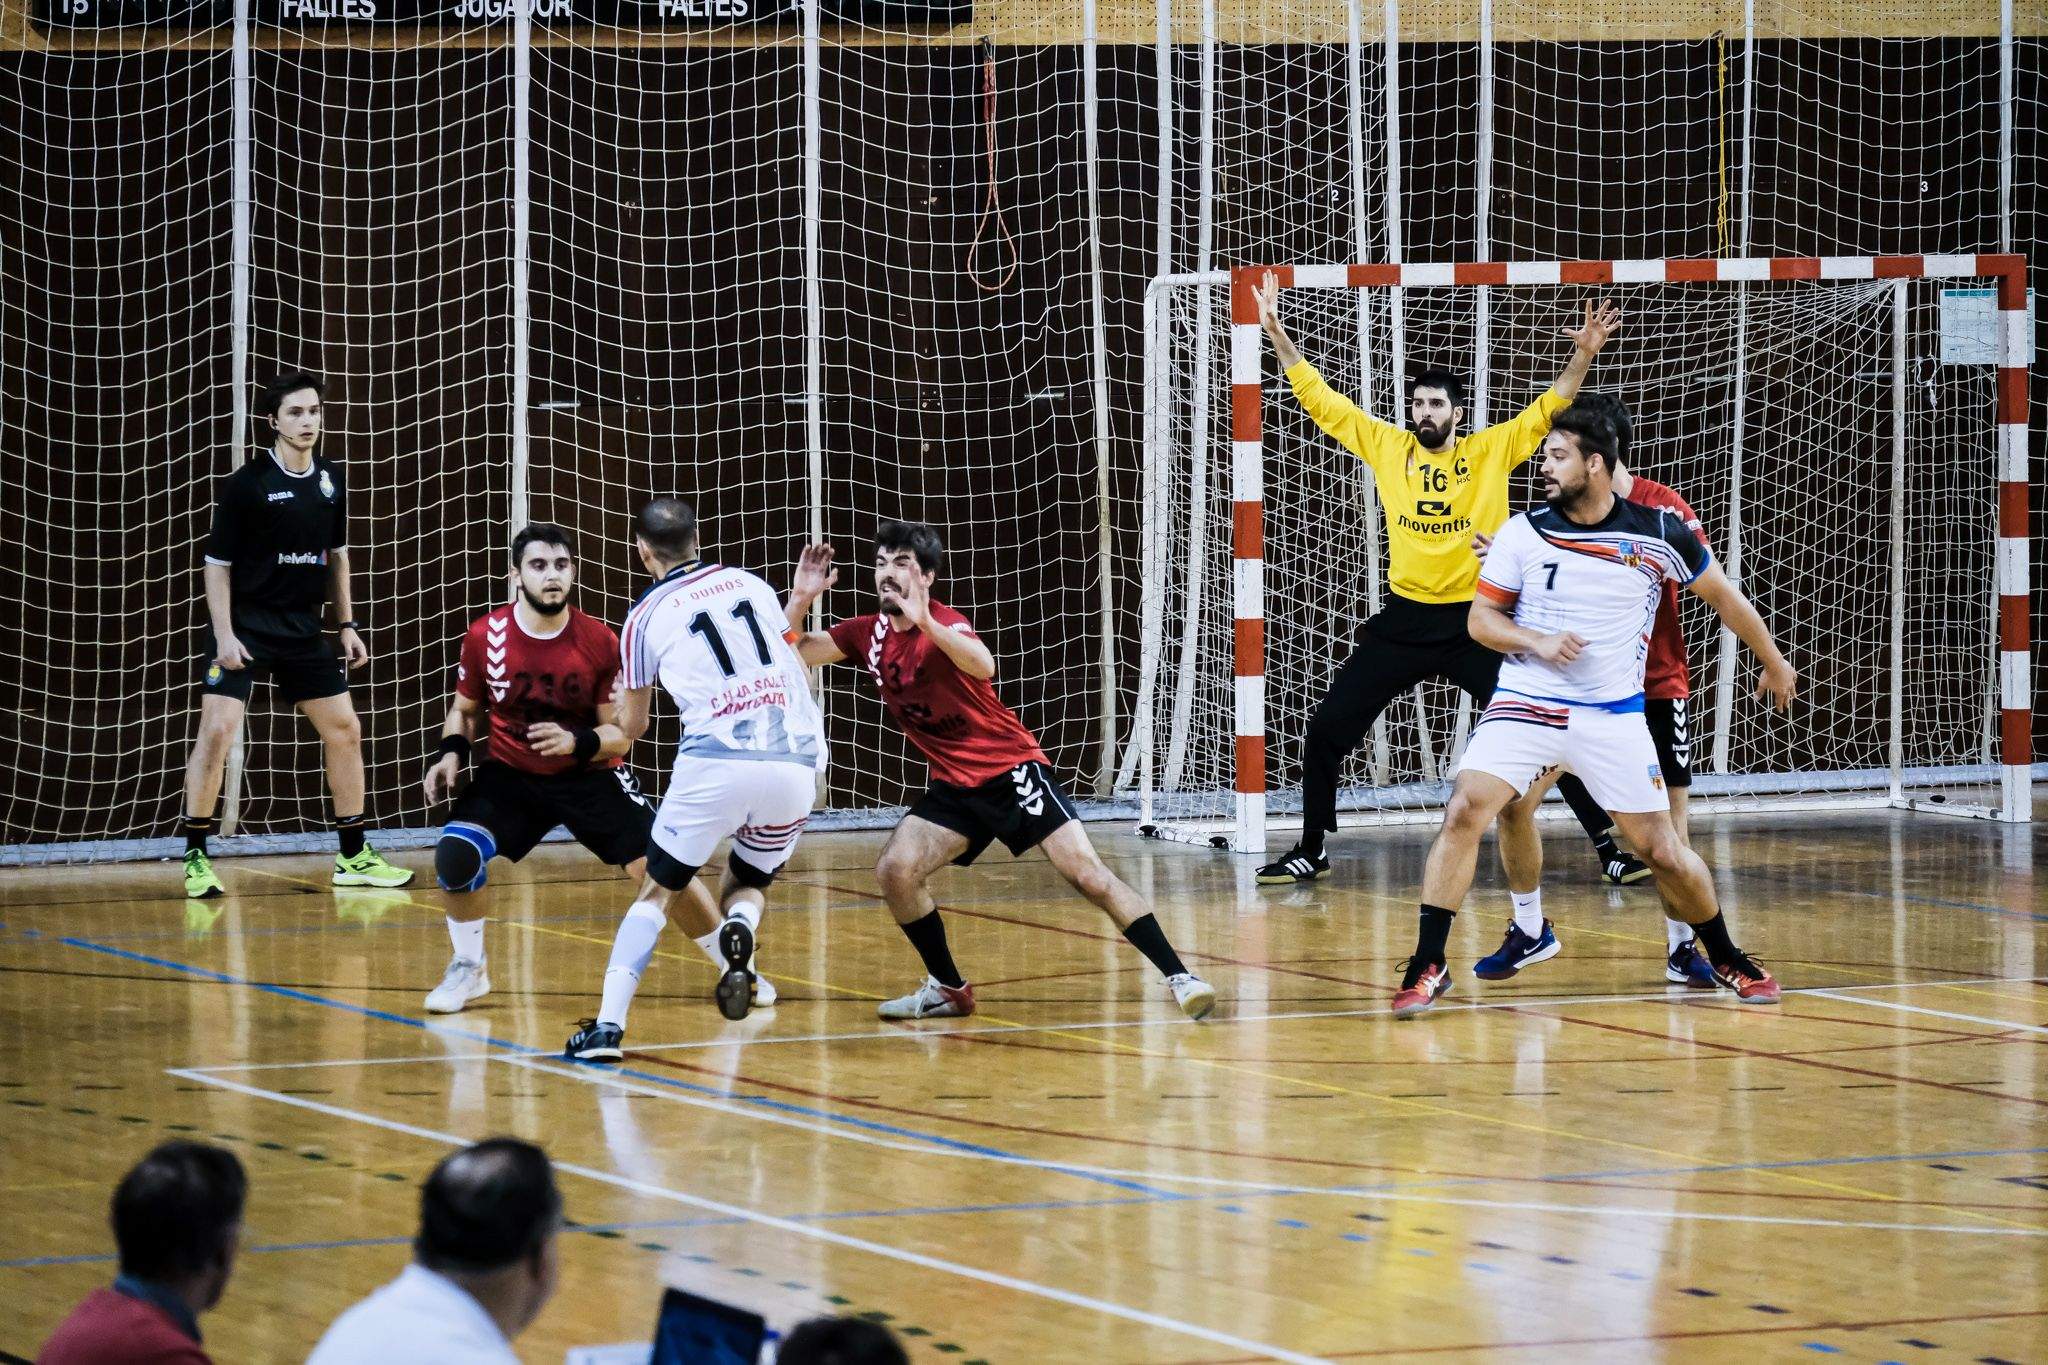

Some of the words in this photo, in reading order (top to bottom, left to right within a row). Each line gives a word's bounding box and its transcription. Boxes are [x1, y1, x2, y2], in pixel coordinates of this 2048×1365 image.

[283, 0, 377, 18] FALTES
[658, 0, 748, 17] FALTES
[1332, 189, 1340, 202] 2
[1921, 181, 1929, 193] 3
[1418, 463, 1449, 493] 16
[1397, 515, 1472, 534] moventis
[1543, 562, 1560, 591] 7
[686, 598, 775, 679] 11
